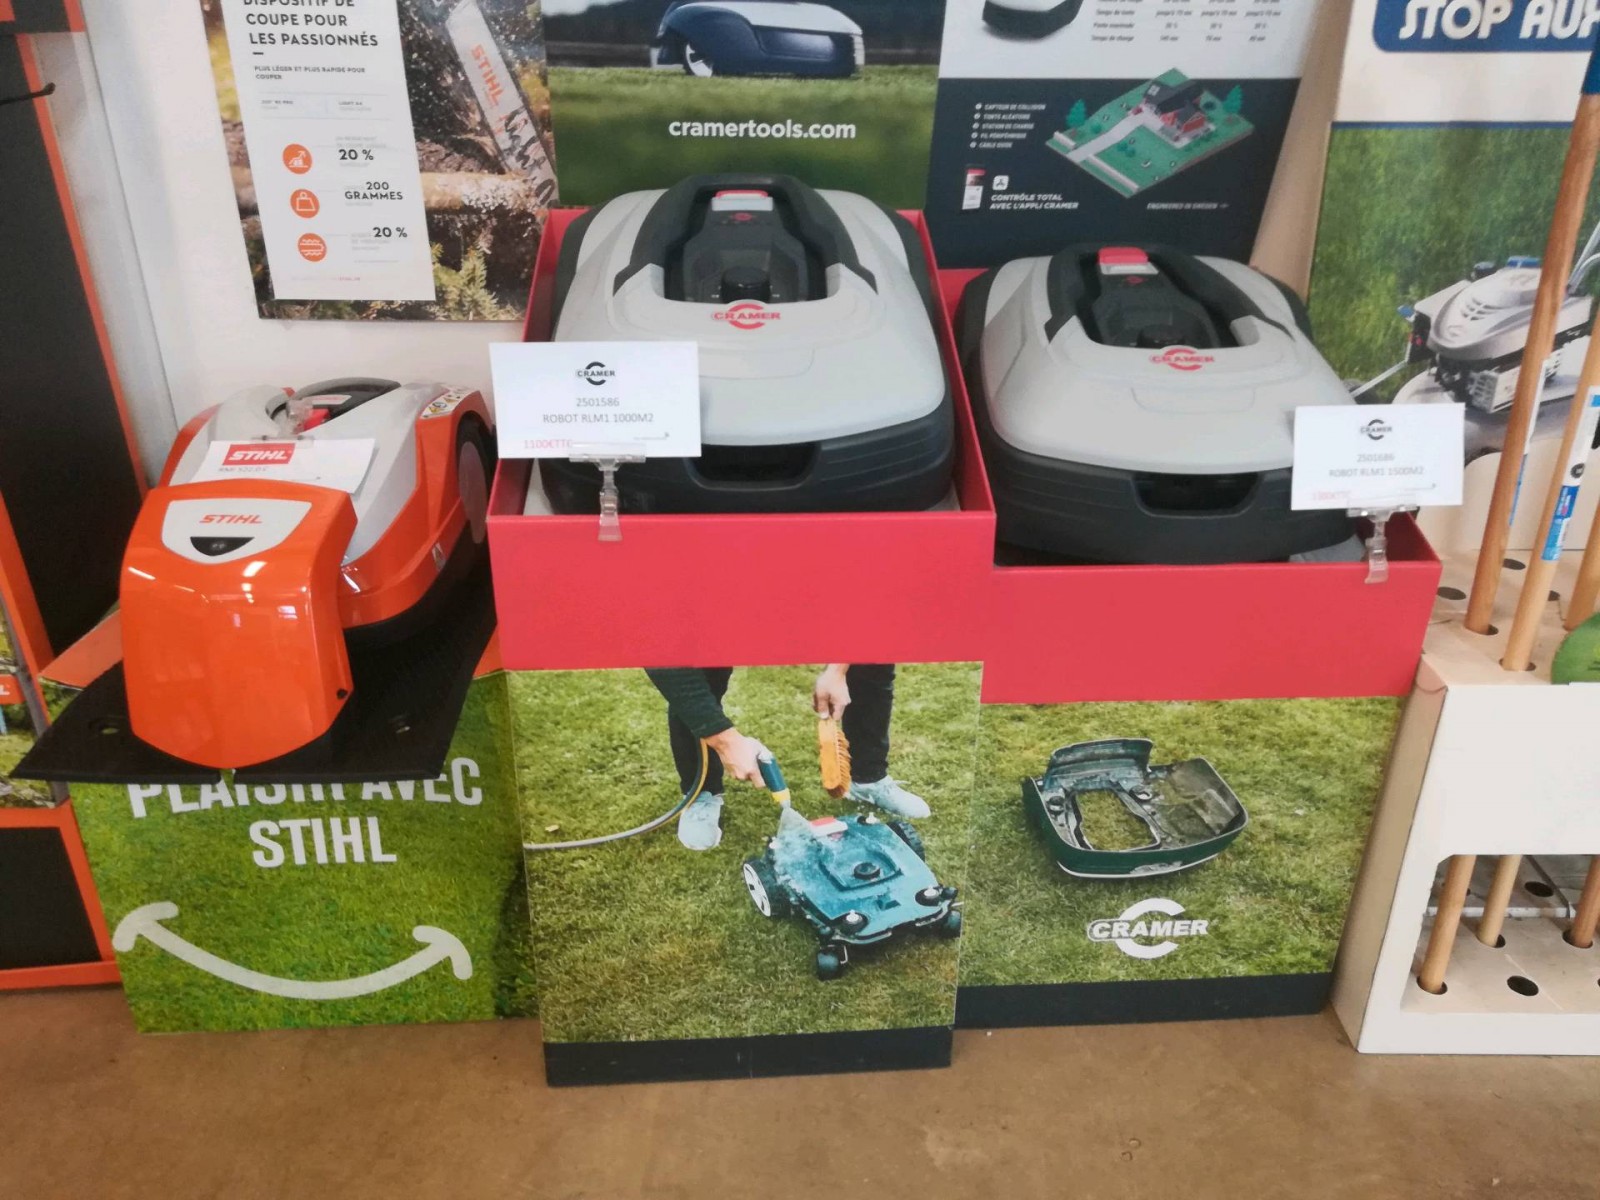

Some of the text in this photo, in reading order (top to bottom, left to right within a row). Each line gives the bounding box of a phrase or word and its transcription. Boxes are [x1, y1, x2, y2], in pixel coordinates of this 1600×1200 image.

[246, 13, 347, 26] COUPE POUR
[1399, 0, 1513, 39] STOP
[249, 31, 378, 46] LES PASSIONNÉS
[471, 44, 504, 109] STIHL
[668, 119, 856, 139] cramertools.com
[339, 149, 374, 161] 20 %
[365, 181, 389, 190] 200
[344, 191, 403, 200] GRAMMES
[990, 193, 1036, 201] CONTRÔLE
[989, 202, 1012, 210] AVEC
[372, 226, 392, 238] 20
[395, 227, 407, 238] %
[713, 311, 781, 320] CRAMER
[1151, 355, 1215, 363] CRAMER
[576, 397, 620, 407] 2501586
[543, 413, 654, 424] ROBOT RLM1 1000M2
[228, 450, 288, 461] STIHL
[1329, 468, 1358, 478] ROBOT
[199, 514, 262, 524] STIHL
[249, 816, 397, 868] STIHL
[1091, 919, 1209, 939] CRAMER
